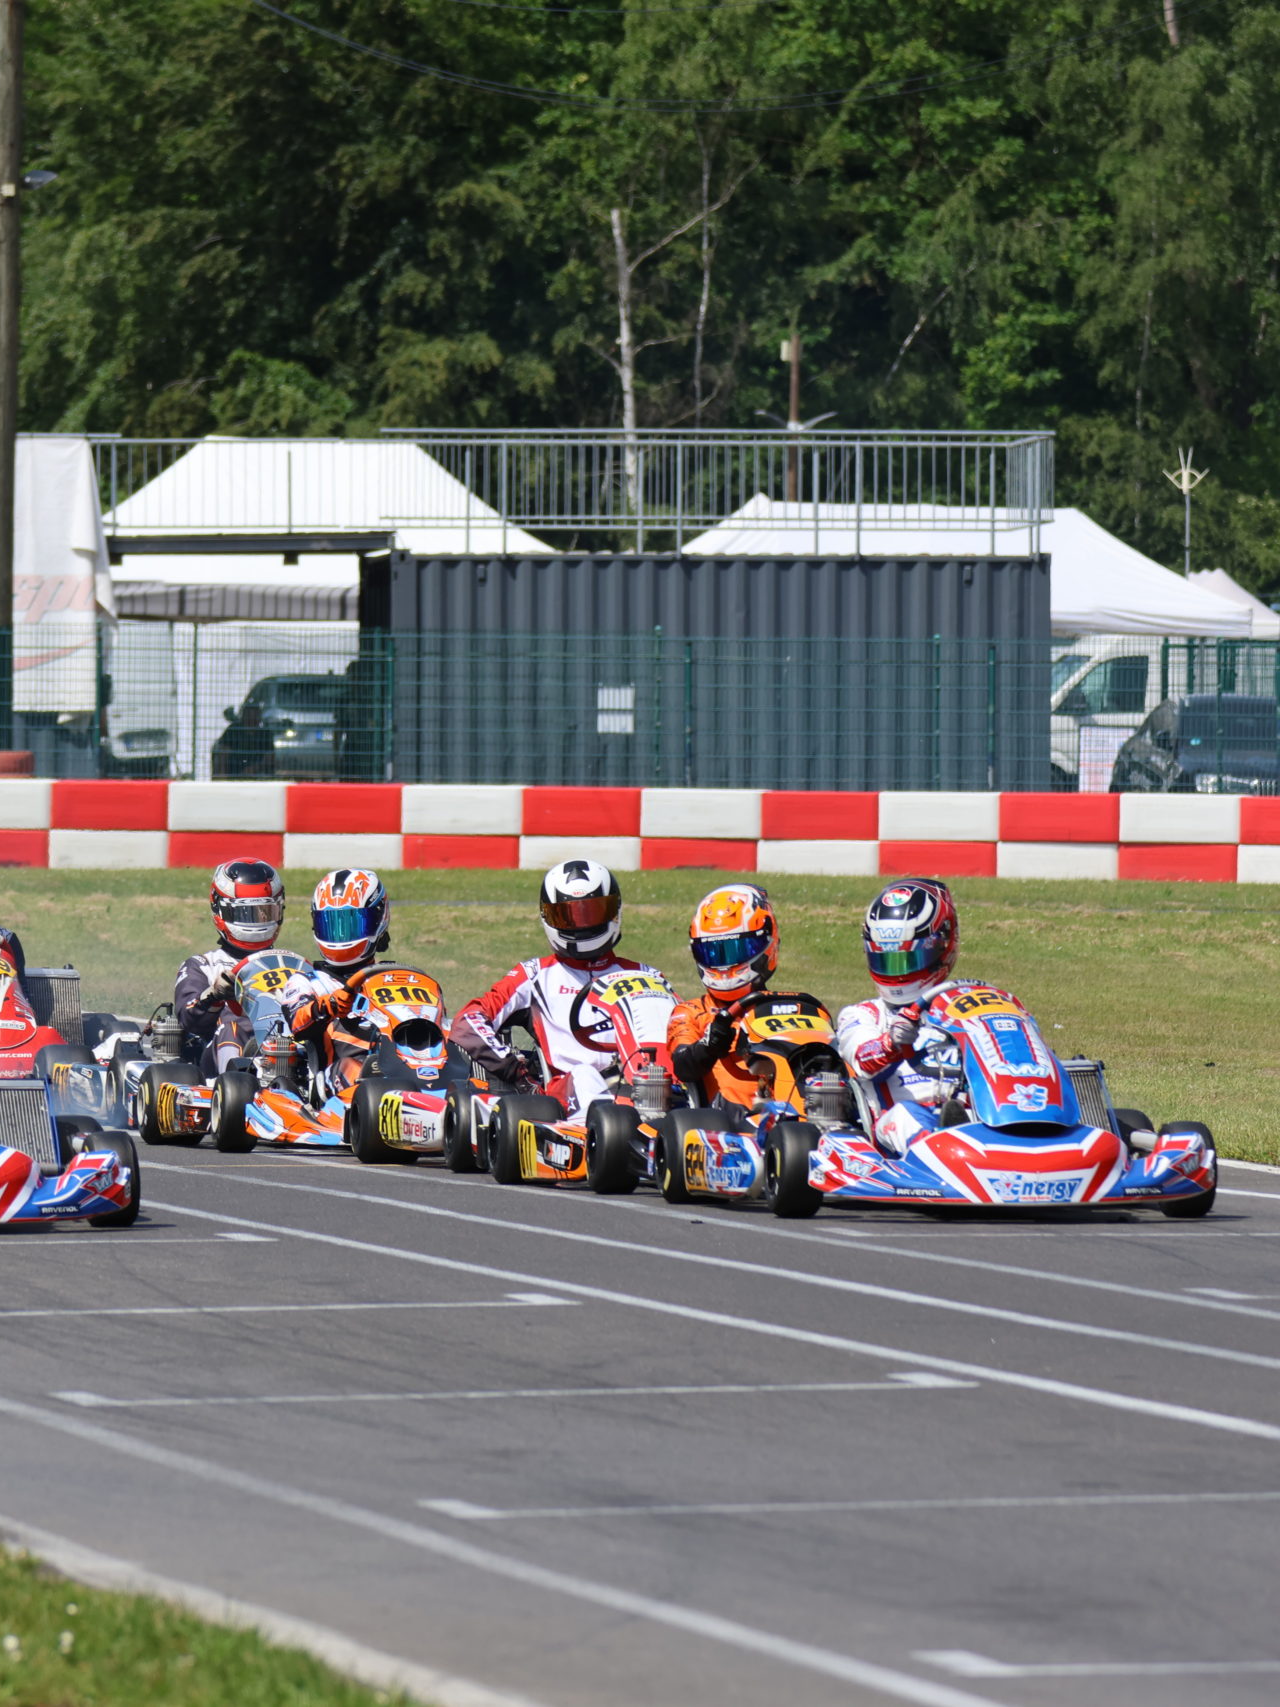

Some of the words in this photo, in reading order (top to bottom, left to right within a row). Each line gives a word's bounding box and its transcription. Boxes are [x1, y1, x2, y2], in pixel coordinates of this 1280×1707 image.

[262, 969, 293, 988] 81
[383, 974, 419, 984] KSL
[375, 986, 433, 1004] 810
[771, 1004, 798, 1015] MP
[765, 1017, 814, 1033] 817
[402, 1117, 436, 1142] birelart
[551, 1142, 570, 1164] MP
[896, 1188, 941, 1197] RAVENOL
[1008, 1175, 1080, 1200] Energy
[41, 1205, 79, 1214] RAVENOL
